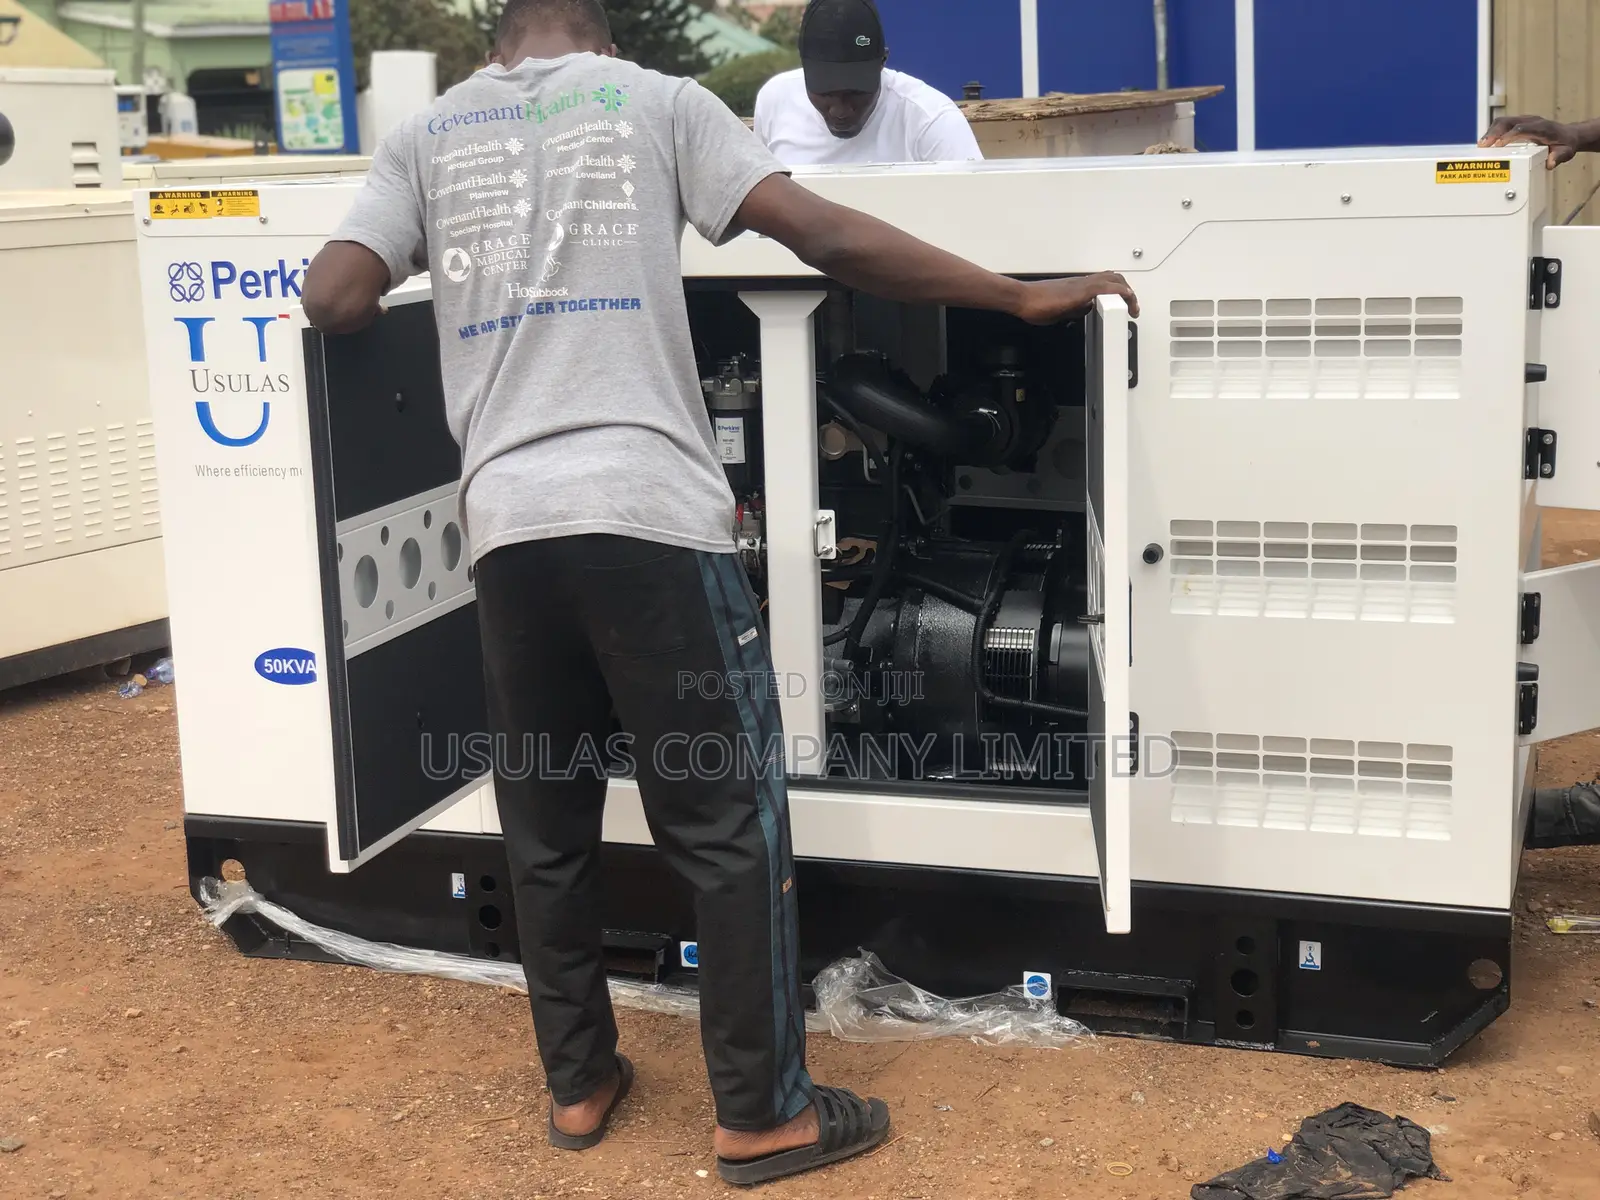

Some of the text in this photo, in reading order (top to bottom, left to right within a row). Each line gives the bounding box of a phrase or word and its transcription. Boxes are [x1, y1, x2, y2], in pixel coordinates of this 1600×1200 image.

[431, 140, 503, 165] ovenantHealth
[557, 135, 615, 153] Medical Center
[477, 155, 505, 165] Group
[575, 171, 617, 180] Levelland
[1440, 172, 1457, 180] PARK
[469, 188, 509, 201] Plainview
[449, 219, 514, 238] Specialty Hospital
[569, 222, 637, 236] GRACE
[470, 233, 531, 254] GRACE
[582, 238, 624, 246] CLINIC
[476, 248, 531, 267] MEDICAL
[482, 260, 529, 277] CENTER
[211, 258, 310, 300] Perki
[458, 324, 480, 340] WE
[558, 297, 642, 314] TOGETHER
[195, 464, 231, 477] Where
[234, 463, 287, 480] efficiency
[264, 658, 317, 674] 50KVA
